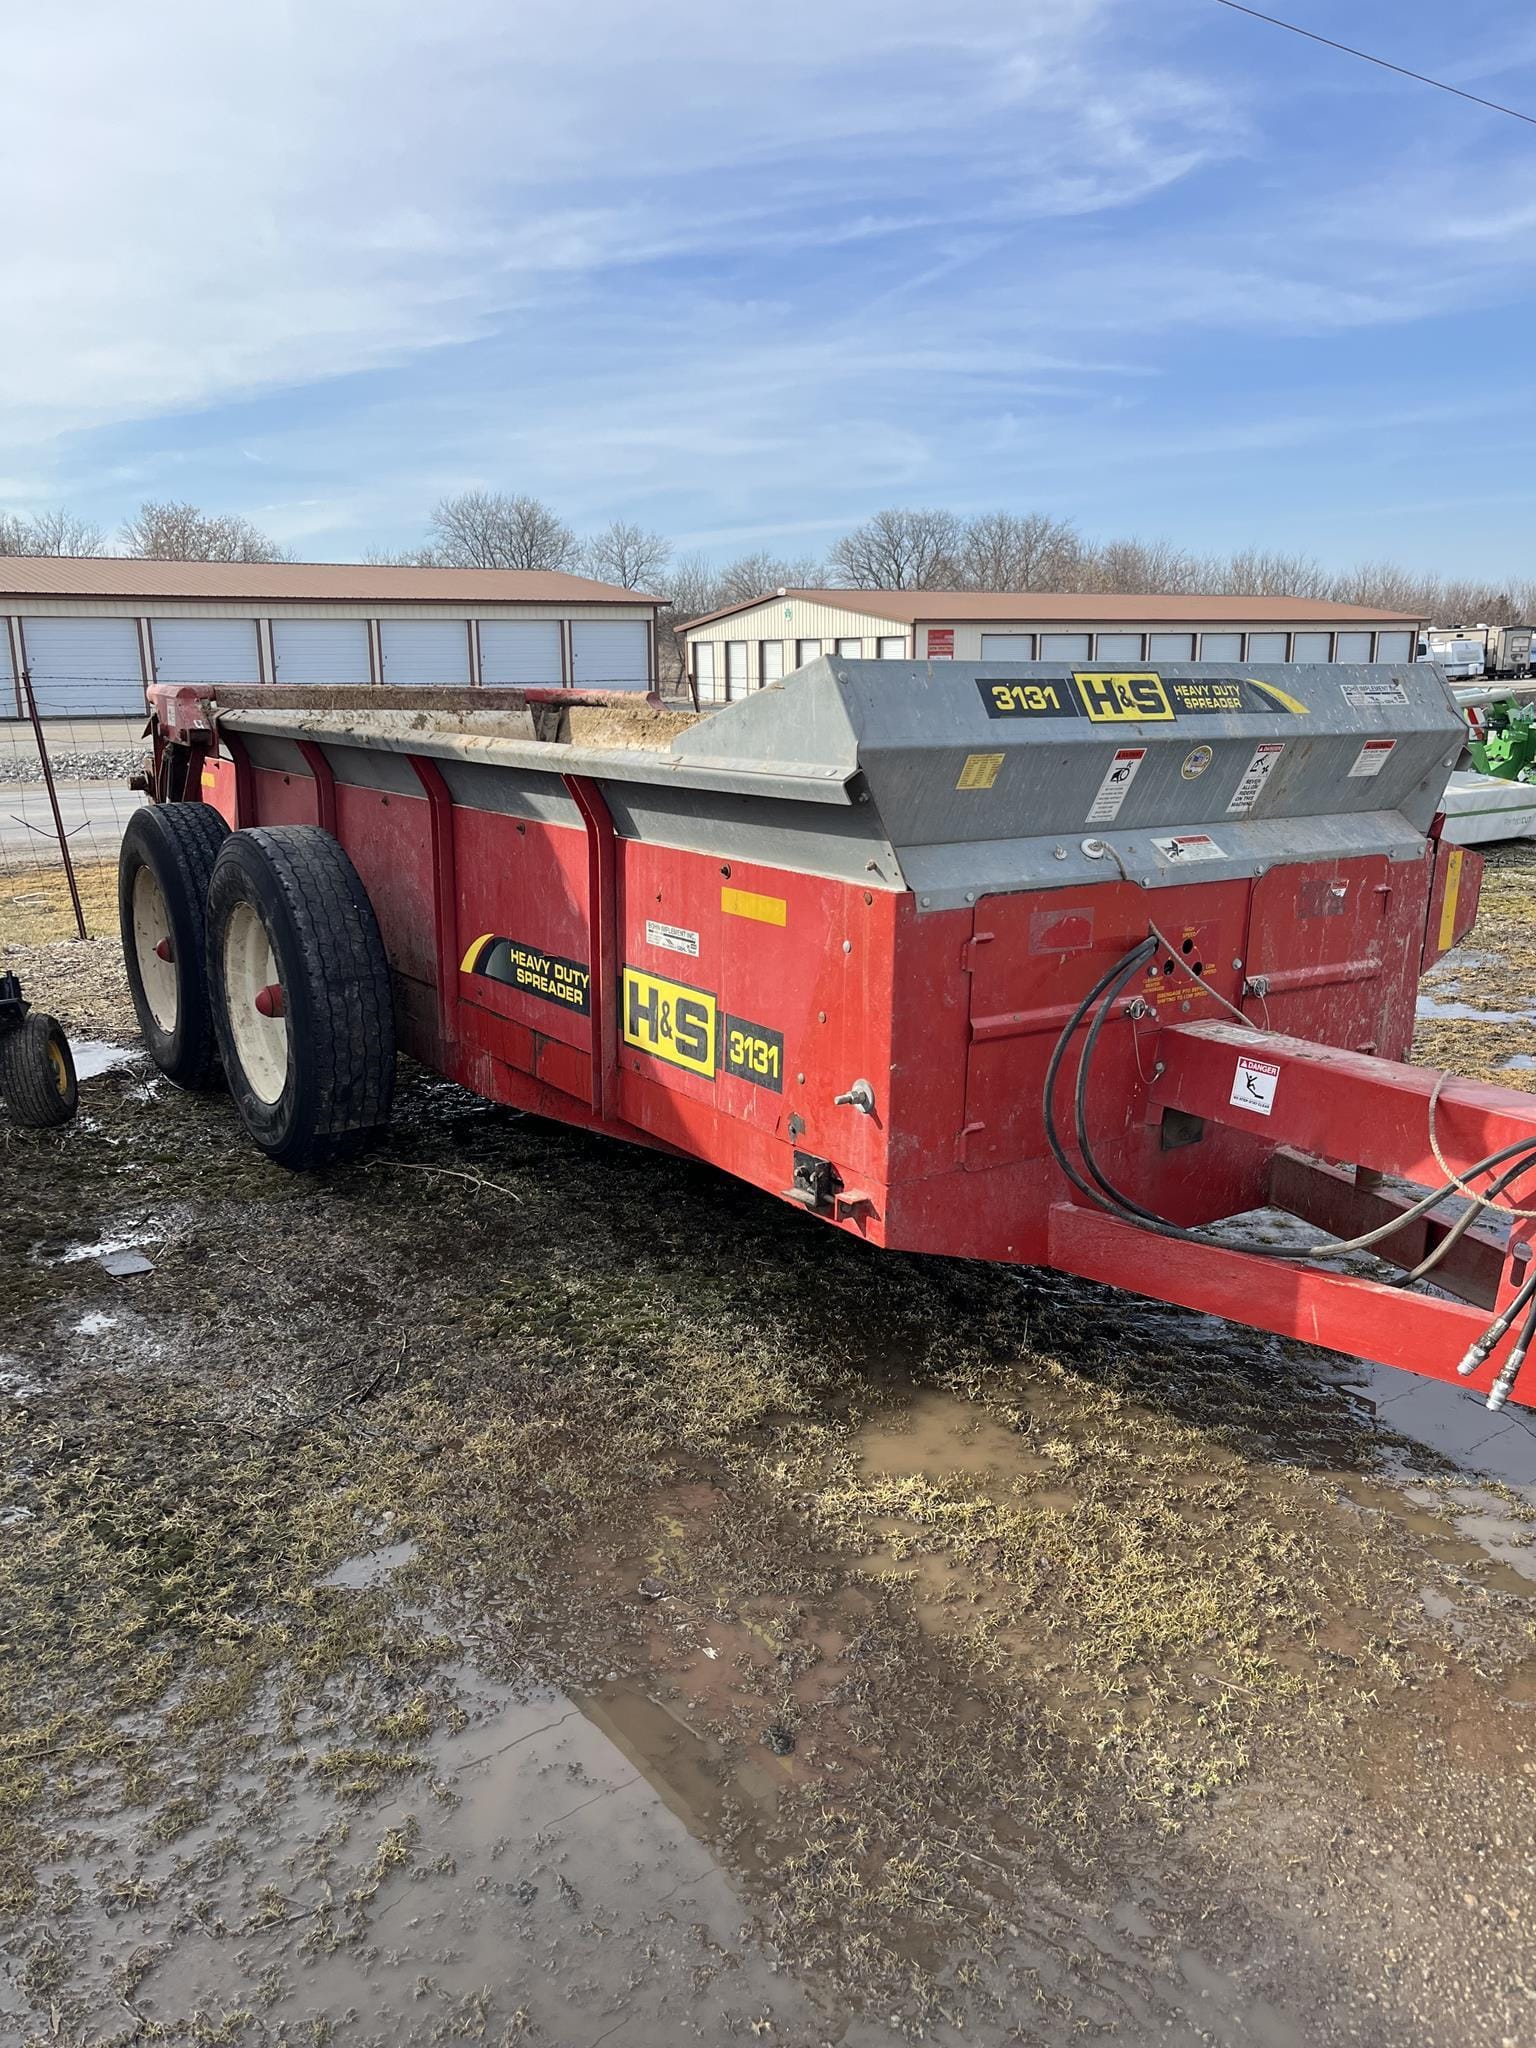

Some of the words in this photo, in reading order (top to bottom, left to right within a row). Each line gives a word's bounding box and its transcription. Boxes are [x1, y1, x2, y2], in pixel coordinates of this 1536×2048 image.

[991, 686, 1061, 710] 3131
[1081, 679, 1167, 715] H&S
[1173, 685, 1209, 697] HEAVY
[1212, 685, 1241, 697] DUTY
[1184, 697, 1242, 709] SPREADER
[661, 926, 686, 937] IMPLEMENT
[510, 949, 551, 975] HEAVY
[554, 965, 590, 989] DUTY
[516, 968, 583, 1005] SPREADER
[629, 981, 709, 1063] H&S
[730, 1030, 779, 1079] 3131
[1248, 1061, 1277, 1075] DANGER
